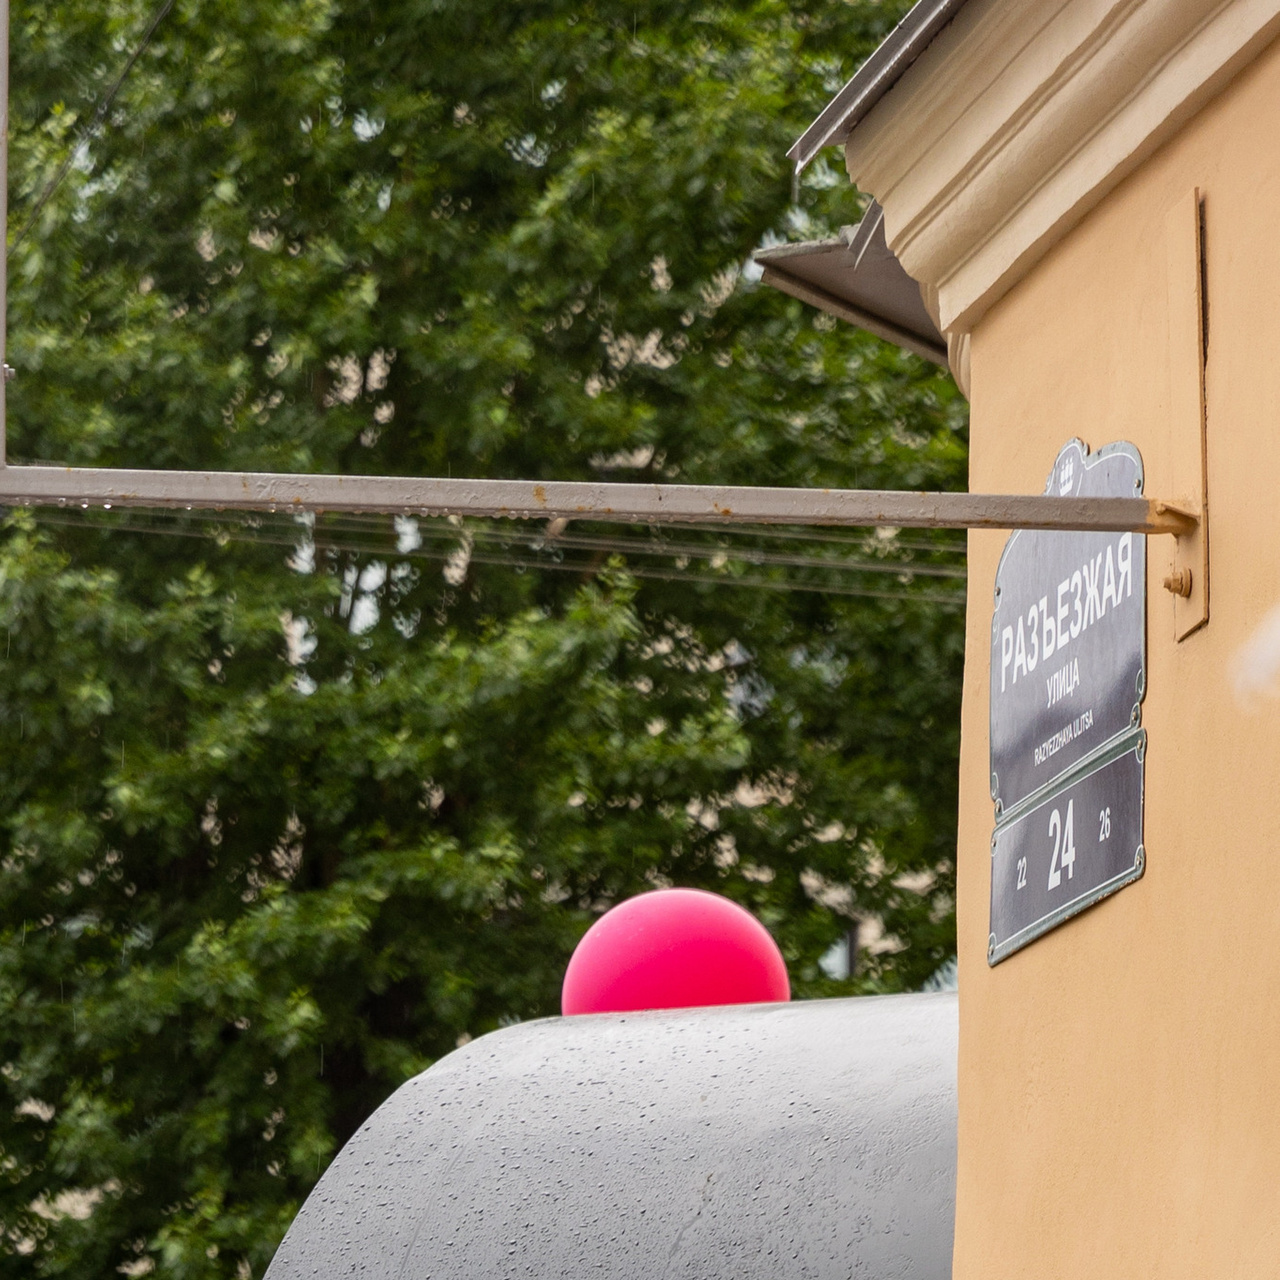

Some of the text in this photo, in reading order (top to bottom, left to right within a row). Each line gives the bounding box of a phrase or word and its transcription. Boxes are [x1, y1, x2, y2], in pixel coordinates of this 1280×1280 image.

[1000, 531, 1133, 693] РАЗЪЕЗЖАЯ
[1046, 657, 1080, 709] УЛИЦА
[1034, 708, 1094, 767] RAZYEZZHAYA ULITSA
[1016, 798, 1111, 892] 22 24 26
